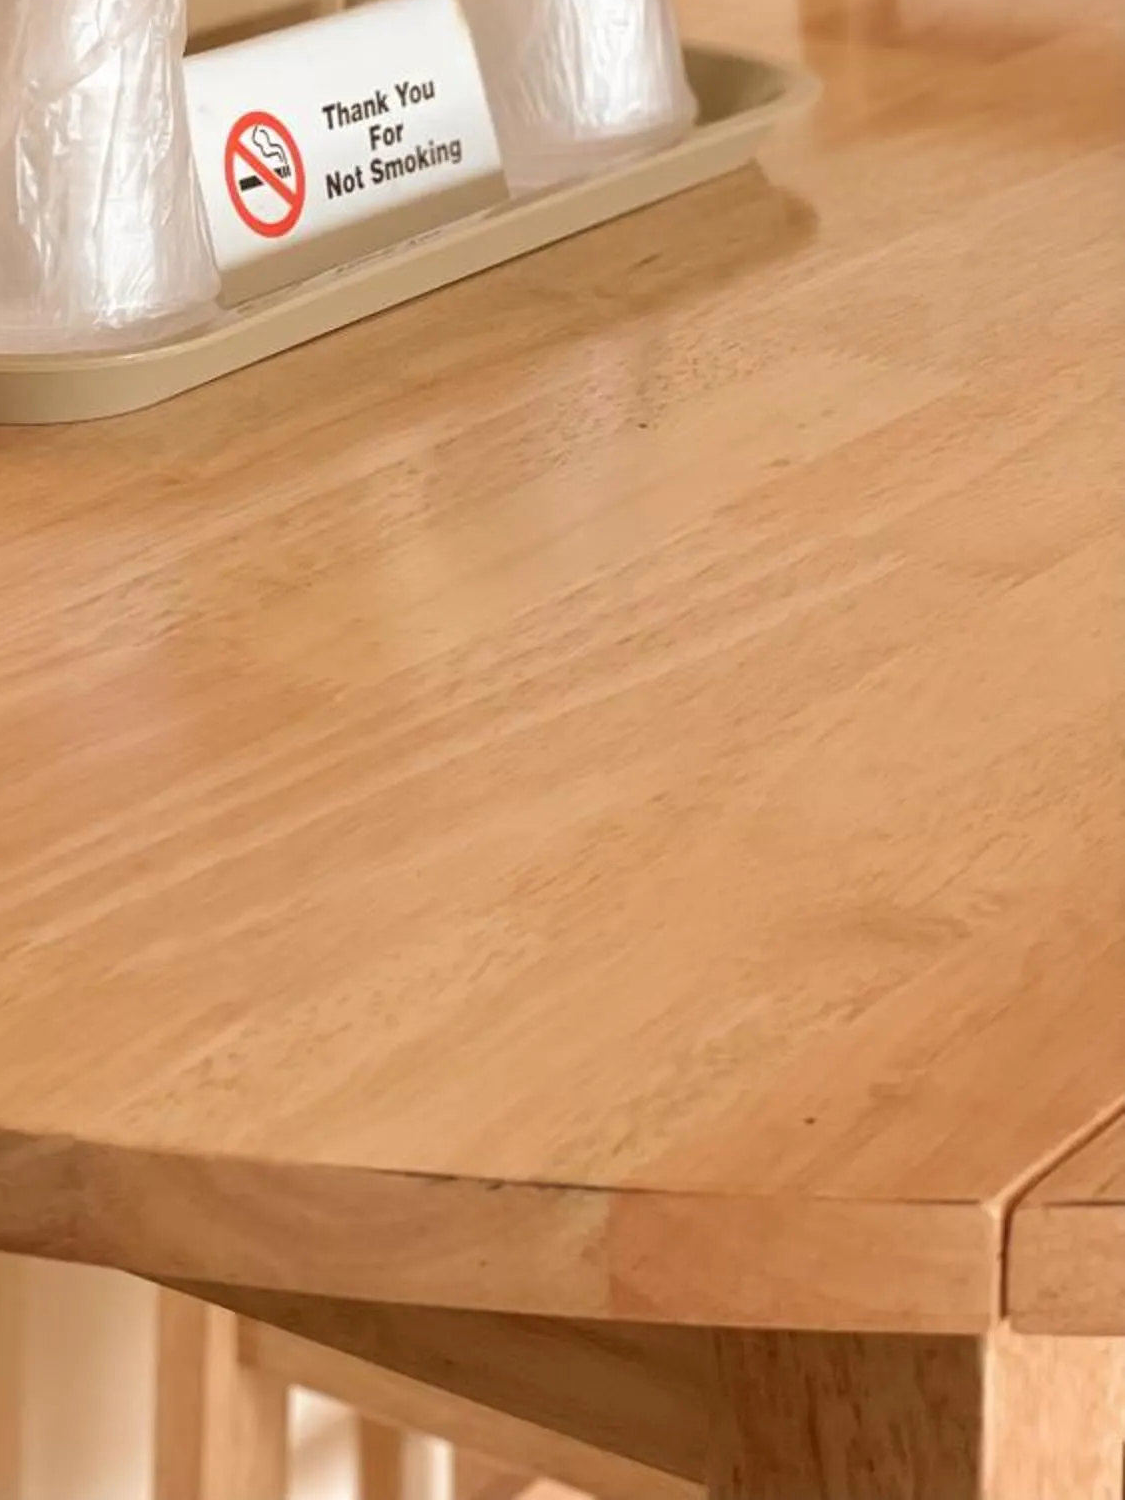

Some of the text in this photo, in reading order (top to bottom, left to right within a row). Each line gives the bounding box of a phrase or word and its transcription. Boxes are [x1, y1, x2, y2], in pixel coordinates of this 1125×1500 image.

[322, 80, 435, 130] Thank You
[369, 123, 404, 150] For
[326, 138, 462, 199] Not Smoking
